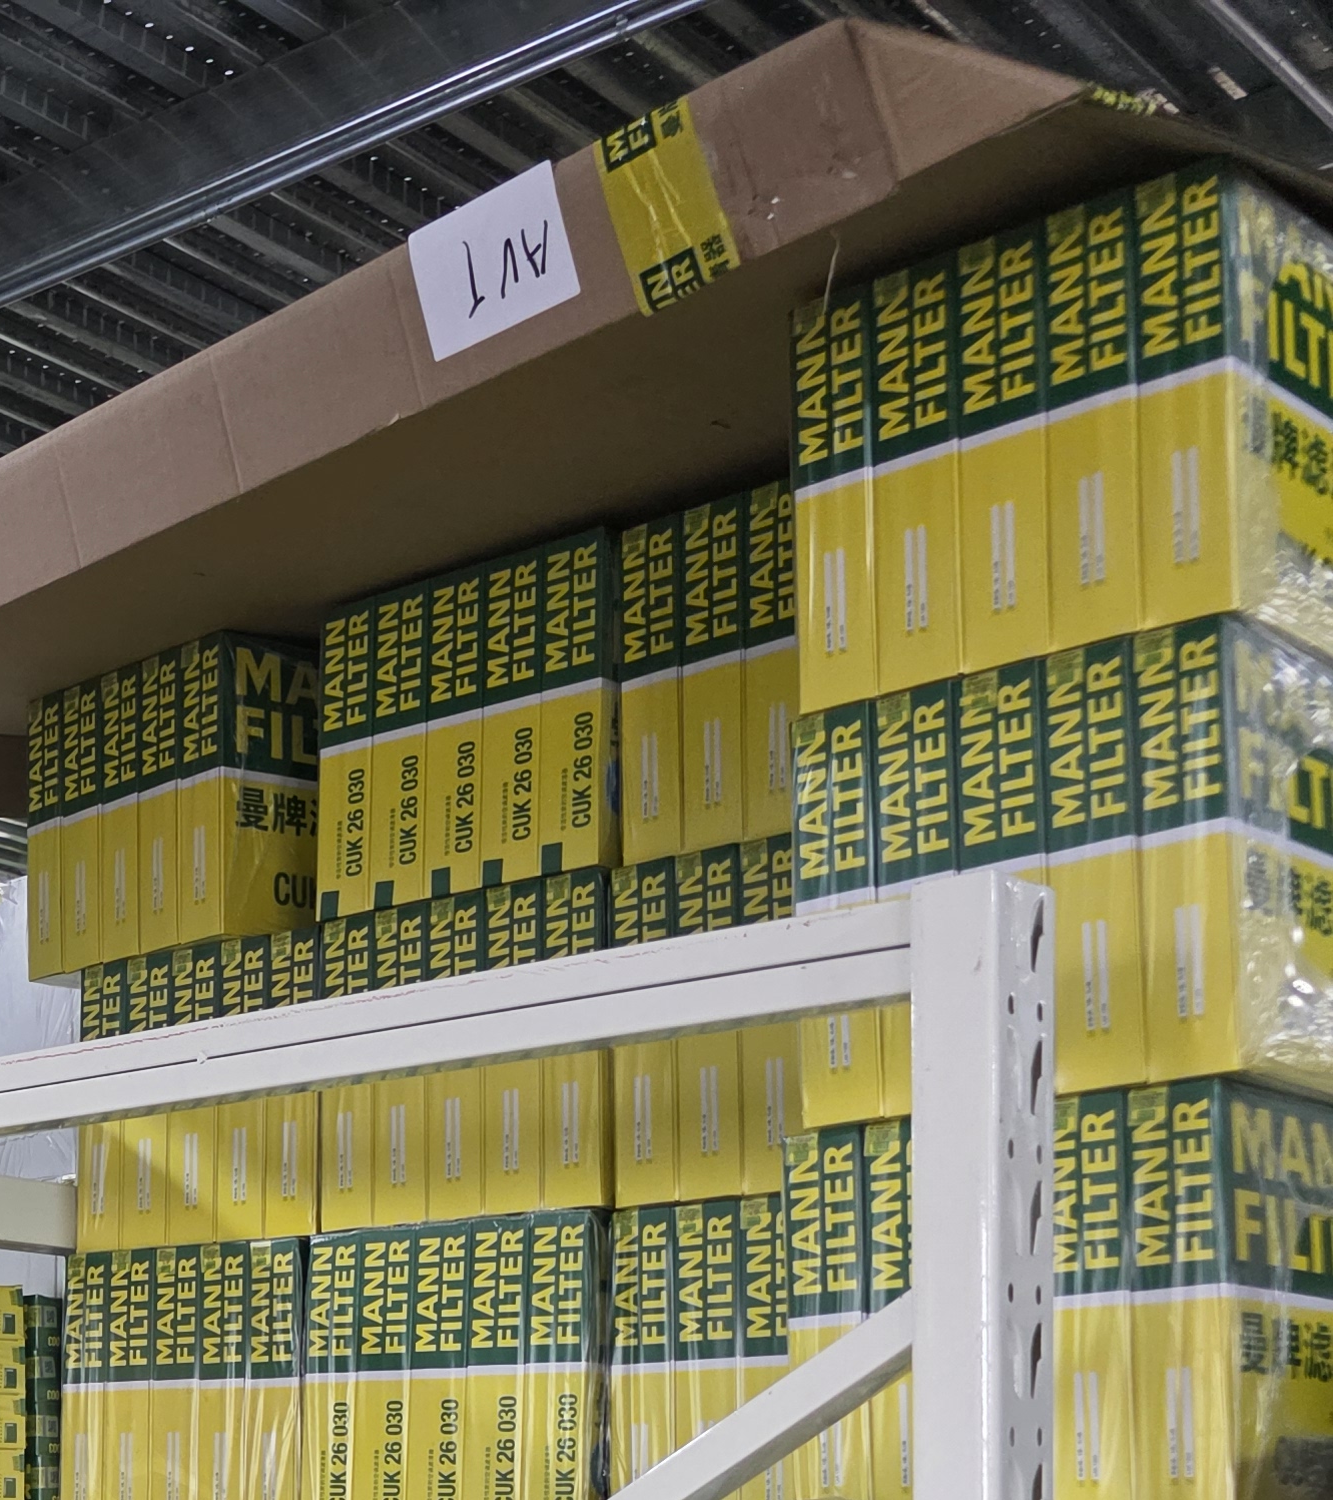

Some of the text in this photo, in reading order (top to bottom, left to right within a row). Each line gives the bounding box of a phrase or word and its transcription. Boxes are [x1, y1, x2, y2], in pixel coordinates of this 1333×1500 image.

[1140, 191, 1177, 359] MANN
[1183, 175, 1221, 345] FILTER
[796, 313, 828, 466] MANN
[834, 302, 863, 454] FILTER
[545, 551, 570, 672] MANN
[573, 542, 597, 666] FILTER
[184, 652, 199, 763] MANN
[201, 644, 219, 756] FILTER
[323, 619, 345, 731] MANN
[346, 609, 369, 726] FILTER
[1181, 633, 1222, 801] FILTER
[572, 712, 593, 828] CUK 26 030
[1138, 650, 1178, 811] MANN
[346, 768, 365, 877] CUK 26 030
[1135, 1105, 1171, 1267] MANN
[1173, 1099, 1214, 1261] FILTER
[157, 1267, 175, 1366] MANN
[177, 1257, 196, 1365] FILTER
[309, 1247, 333, 1357] MANN
[333, 1244, 356, 1356] FILTER
[472, 1232, 497, 1348] MANN
[497, 1229, 524, 1348] FILTER
[497, 1439, 515, 1463] 26
[498, 1396, 517, 1432] 030
